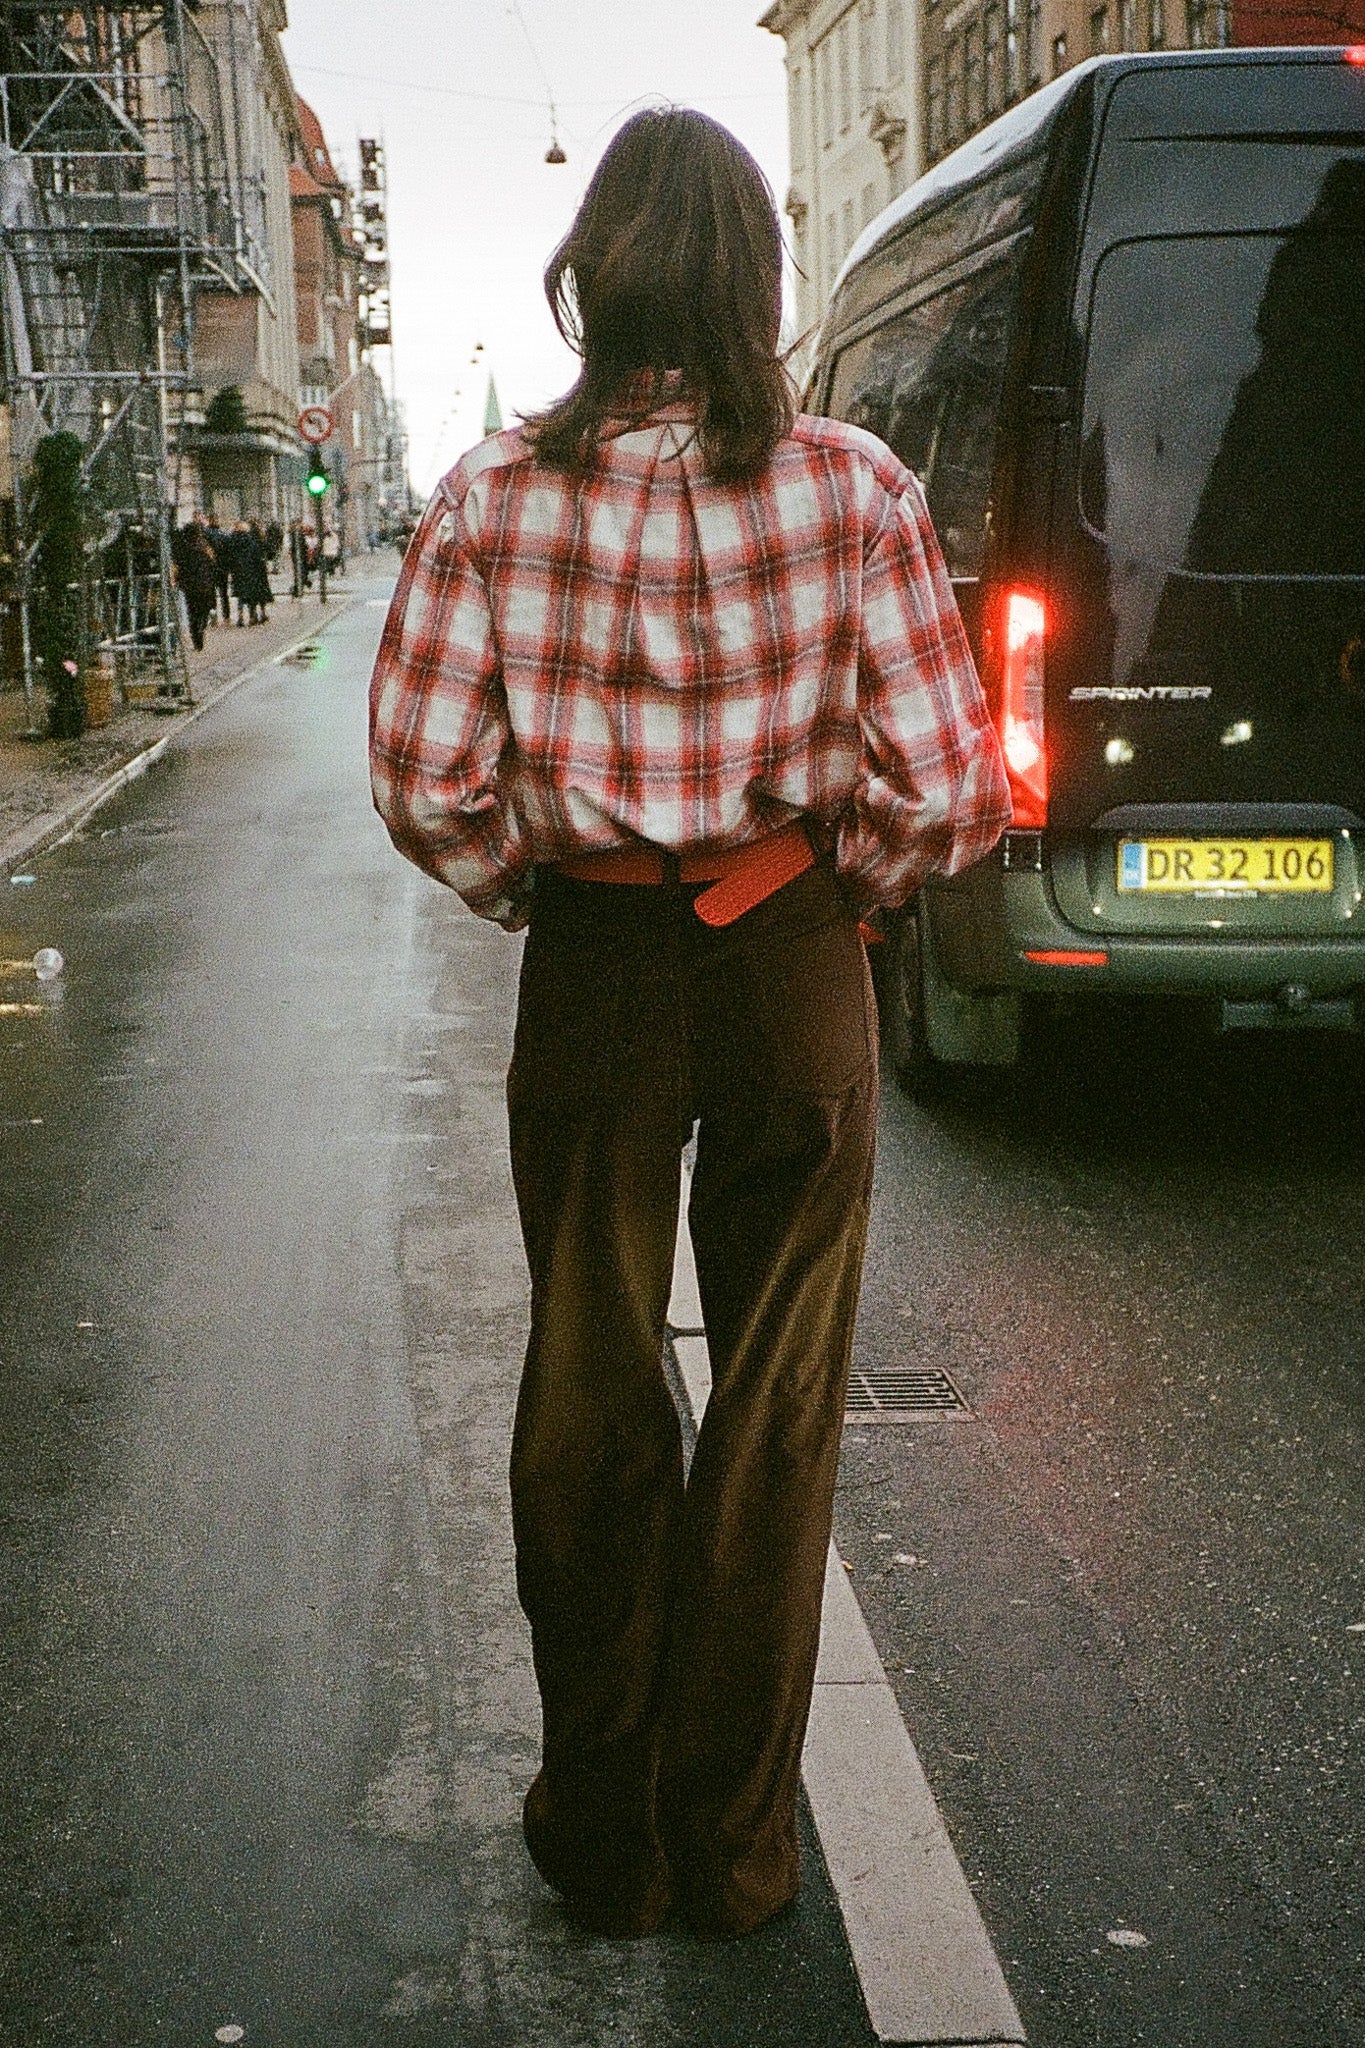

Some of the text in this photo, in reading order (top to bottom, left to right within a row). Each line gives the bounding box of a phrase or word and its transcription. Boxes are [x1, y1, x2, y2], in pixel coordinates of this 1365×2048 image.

[1069, 686, 1213, 701] SPRINTER
[1148, 847, 1325, 881] DR 32 106
